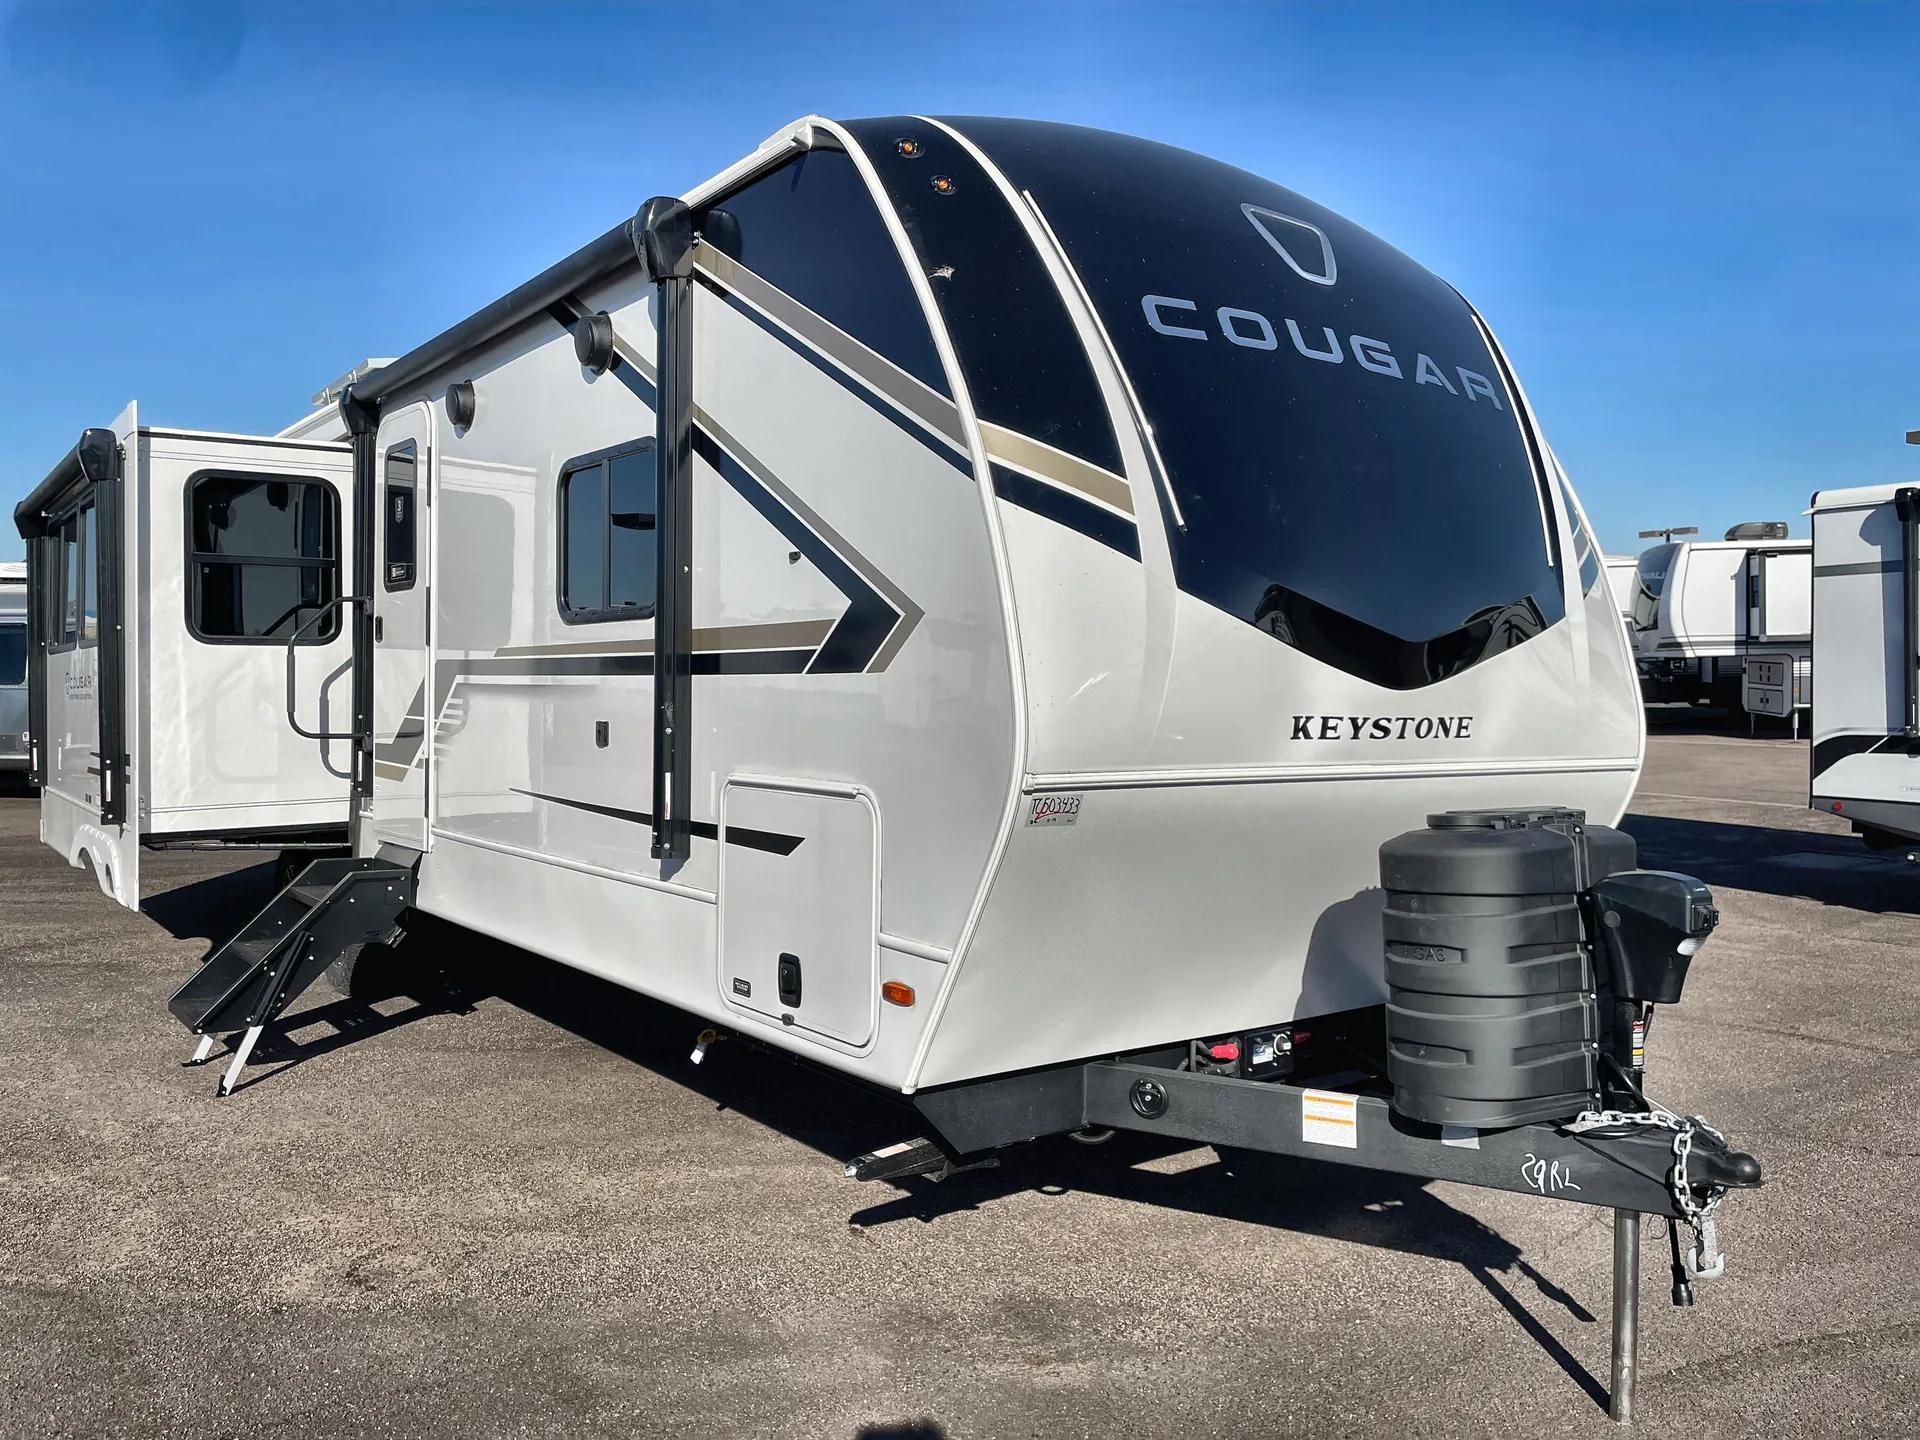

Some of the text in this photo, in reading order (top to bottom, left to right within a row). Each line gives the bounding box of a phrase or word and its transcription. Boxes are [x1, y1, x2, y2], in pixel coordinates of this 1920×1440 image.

[1141, 294, 1503, 411] COUGAR
[70, 675, 92, 689] COUGAR
[1290, 715, 1473, 740] KEYSTONE
[1413, 947, 1446, 962] GAS
